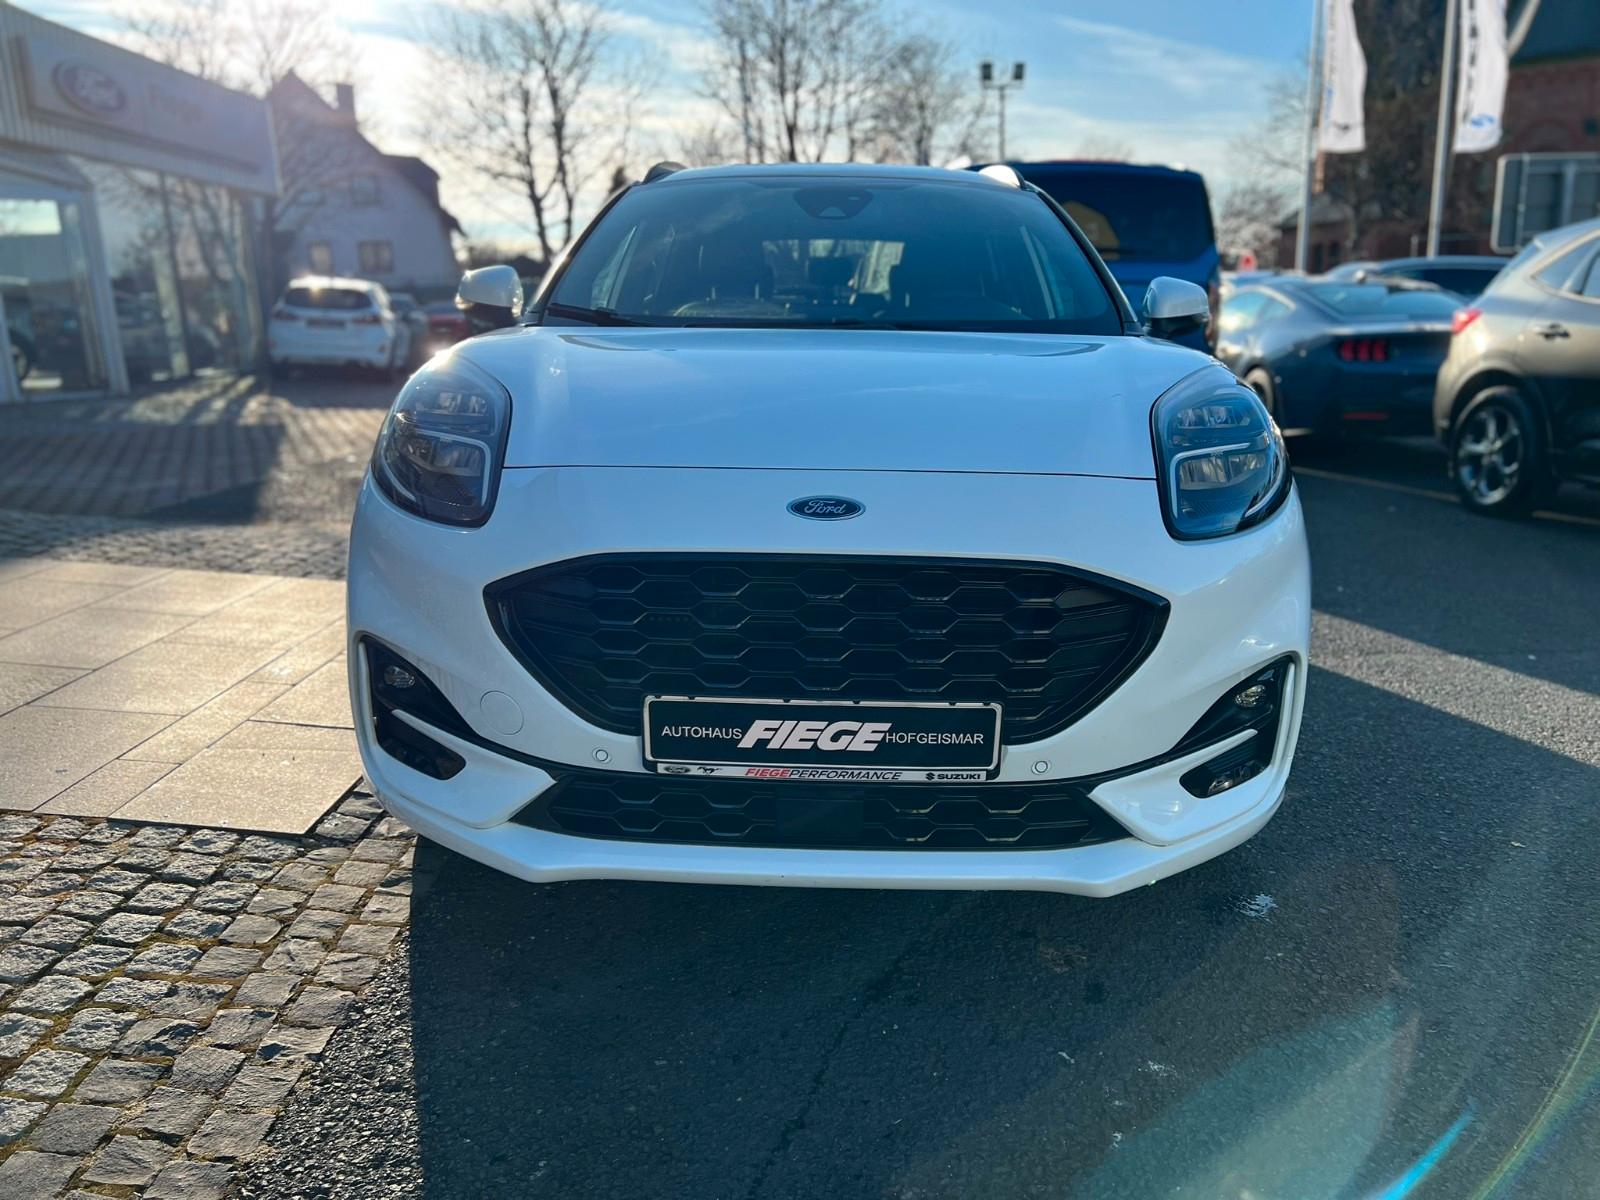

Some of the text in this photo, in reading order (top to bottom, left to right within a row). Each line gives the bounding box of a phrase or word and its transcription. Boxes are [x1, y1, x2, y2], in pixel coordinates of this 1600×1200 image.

[804, 499, 847, 514] Ford
[661, 719, 984, 752] AUTOHAUS FIEGE HOFGEISMAR
